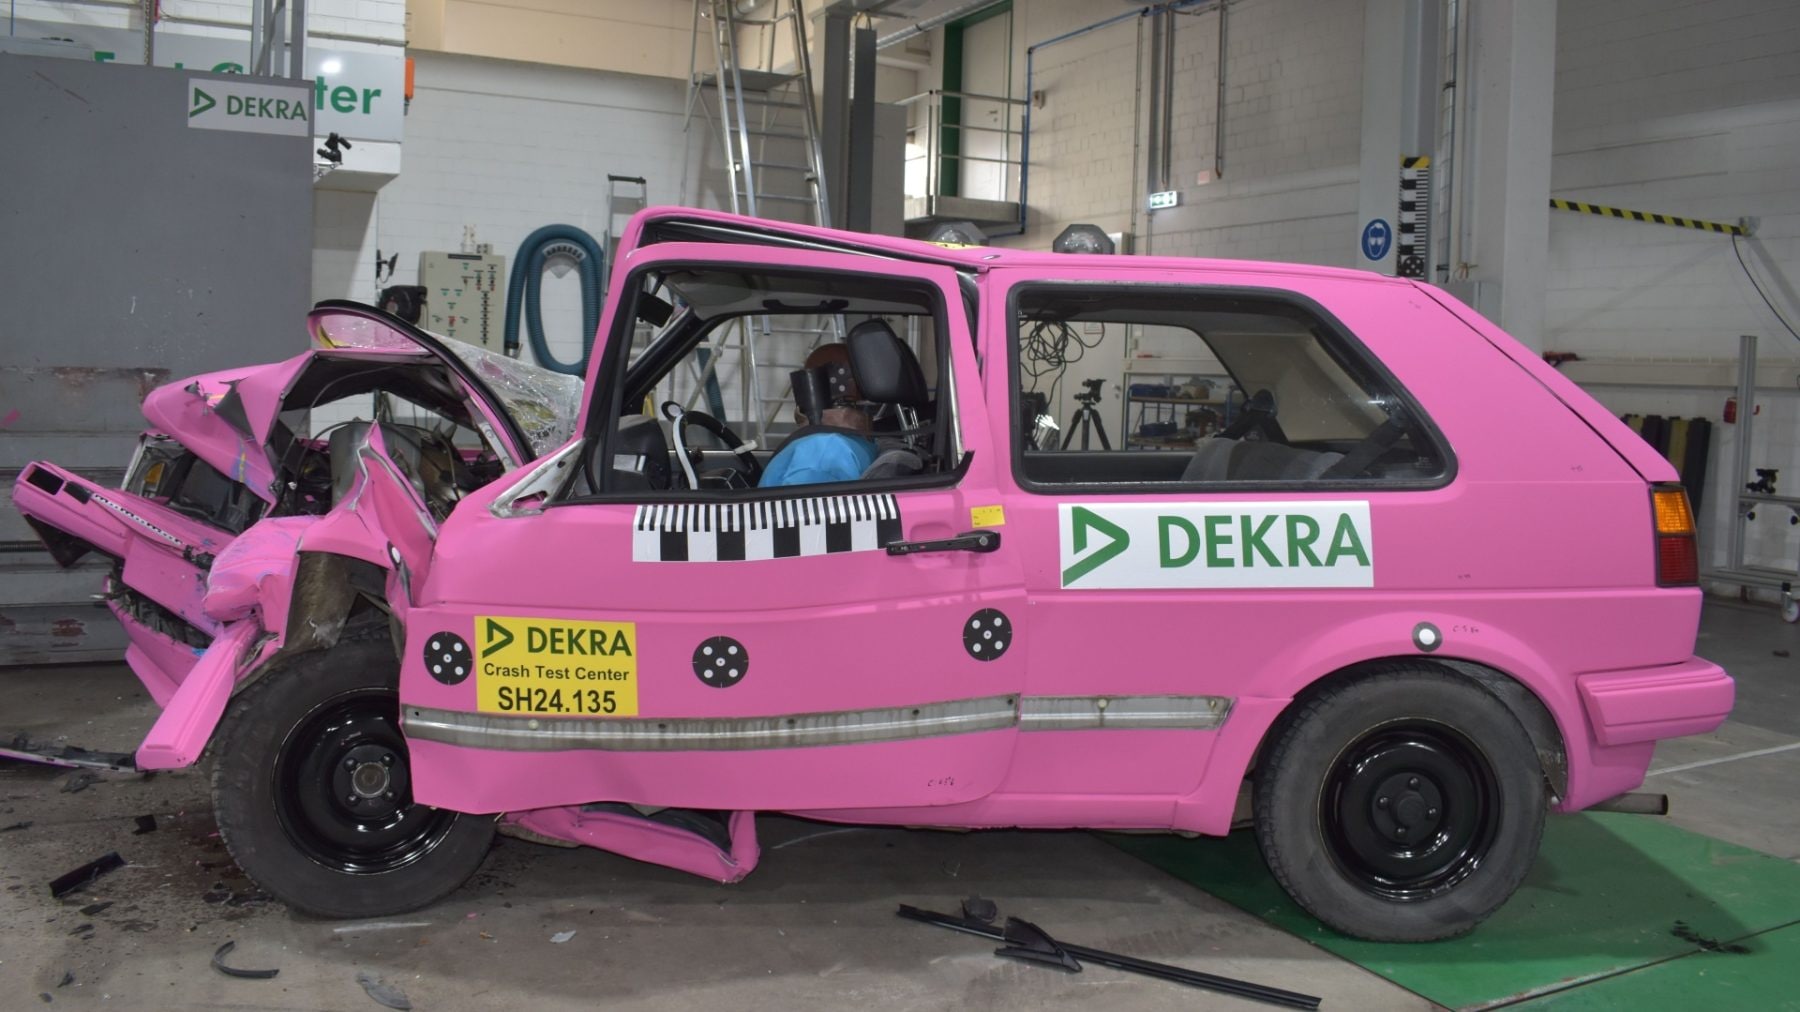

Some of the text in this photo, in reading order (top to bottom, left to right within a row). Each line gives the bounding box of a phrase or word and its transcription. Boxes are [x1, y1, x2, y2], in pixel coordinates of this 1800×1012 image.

[226, 95, 308, 121] DEKRA
[1158, 513, 1371, 568] DEKRA
[527, 627, 633, 656] DEKRA
[484, 663, 630, 681] Crash Test Center
[498, 686, 617, 713] SH24.135
